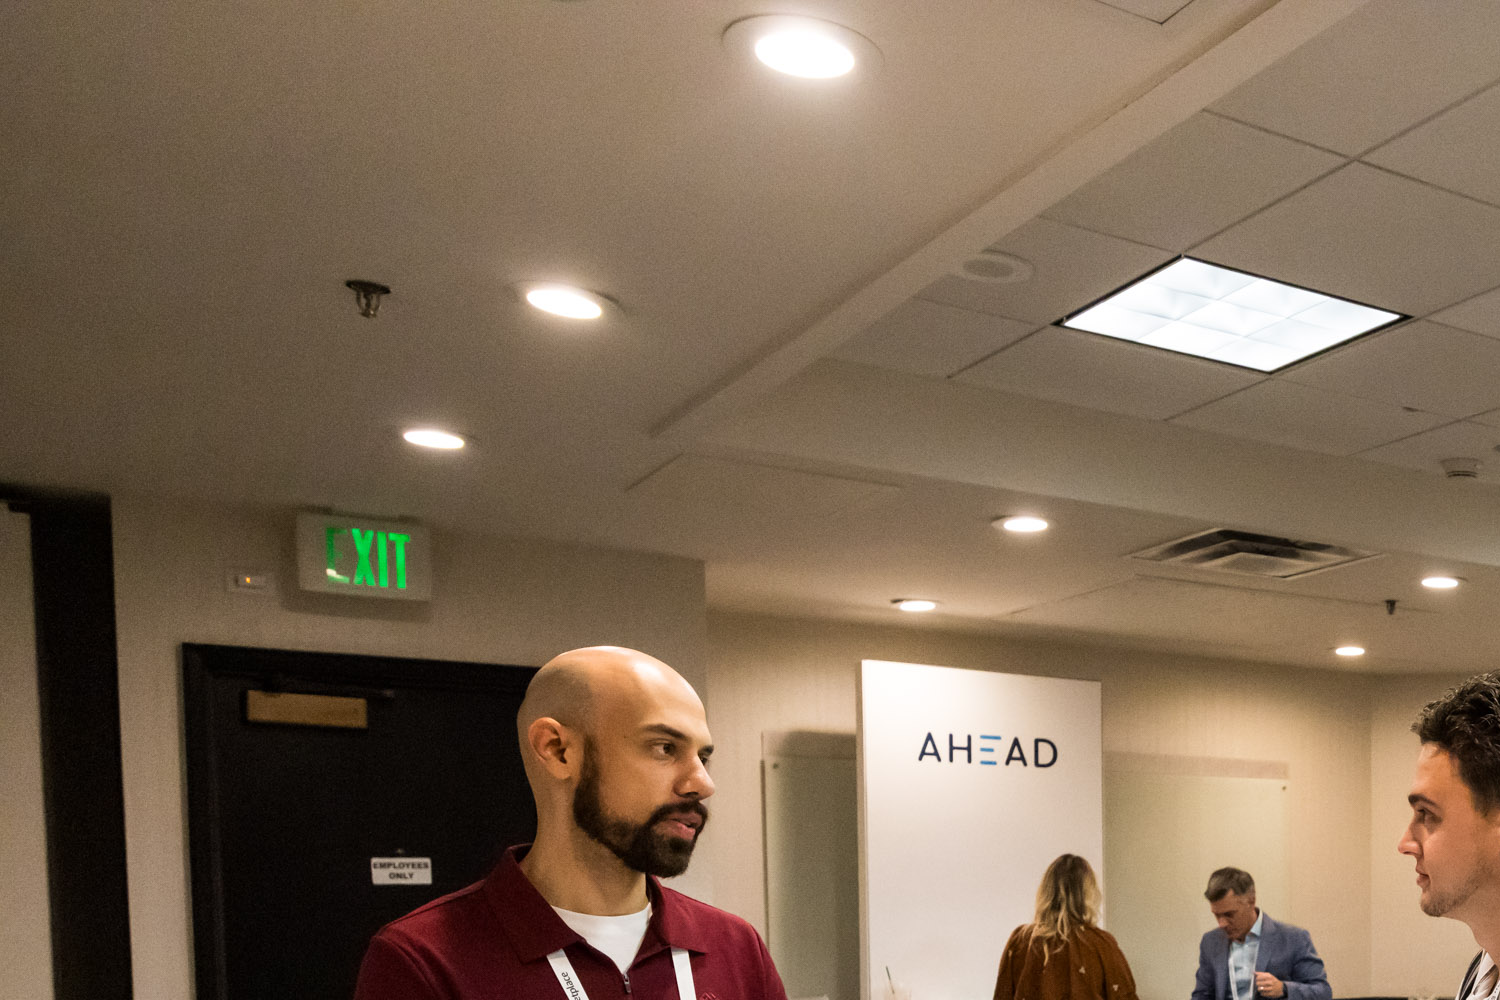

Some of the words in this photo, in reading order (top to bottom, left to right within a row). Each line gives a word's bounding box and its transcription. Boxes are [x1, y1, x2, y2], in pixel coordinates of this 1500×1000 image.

[326, 528, 410, 589] EXIT
[918, 732, 1058, 768] AHEAD
[373, 861, 429, 870] EMPLOYEES
[388, 871, 414, 880] ONLY
